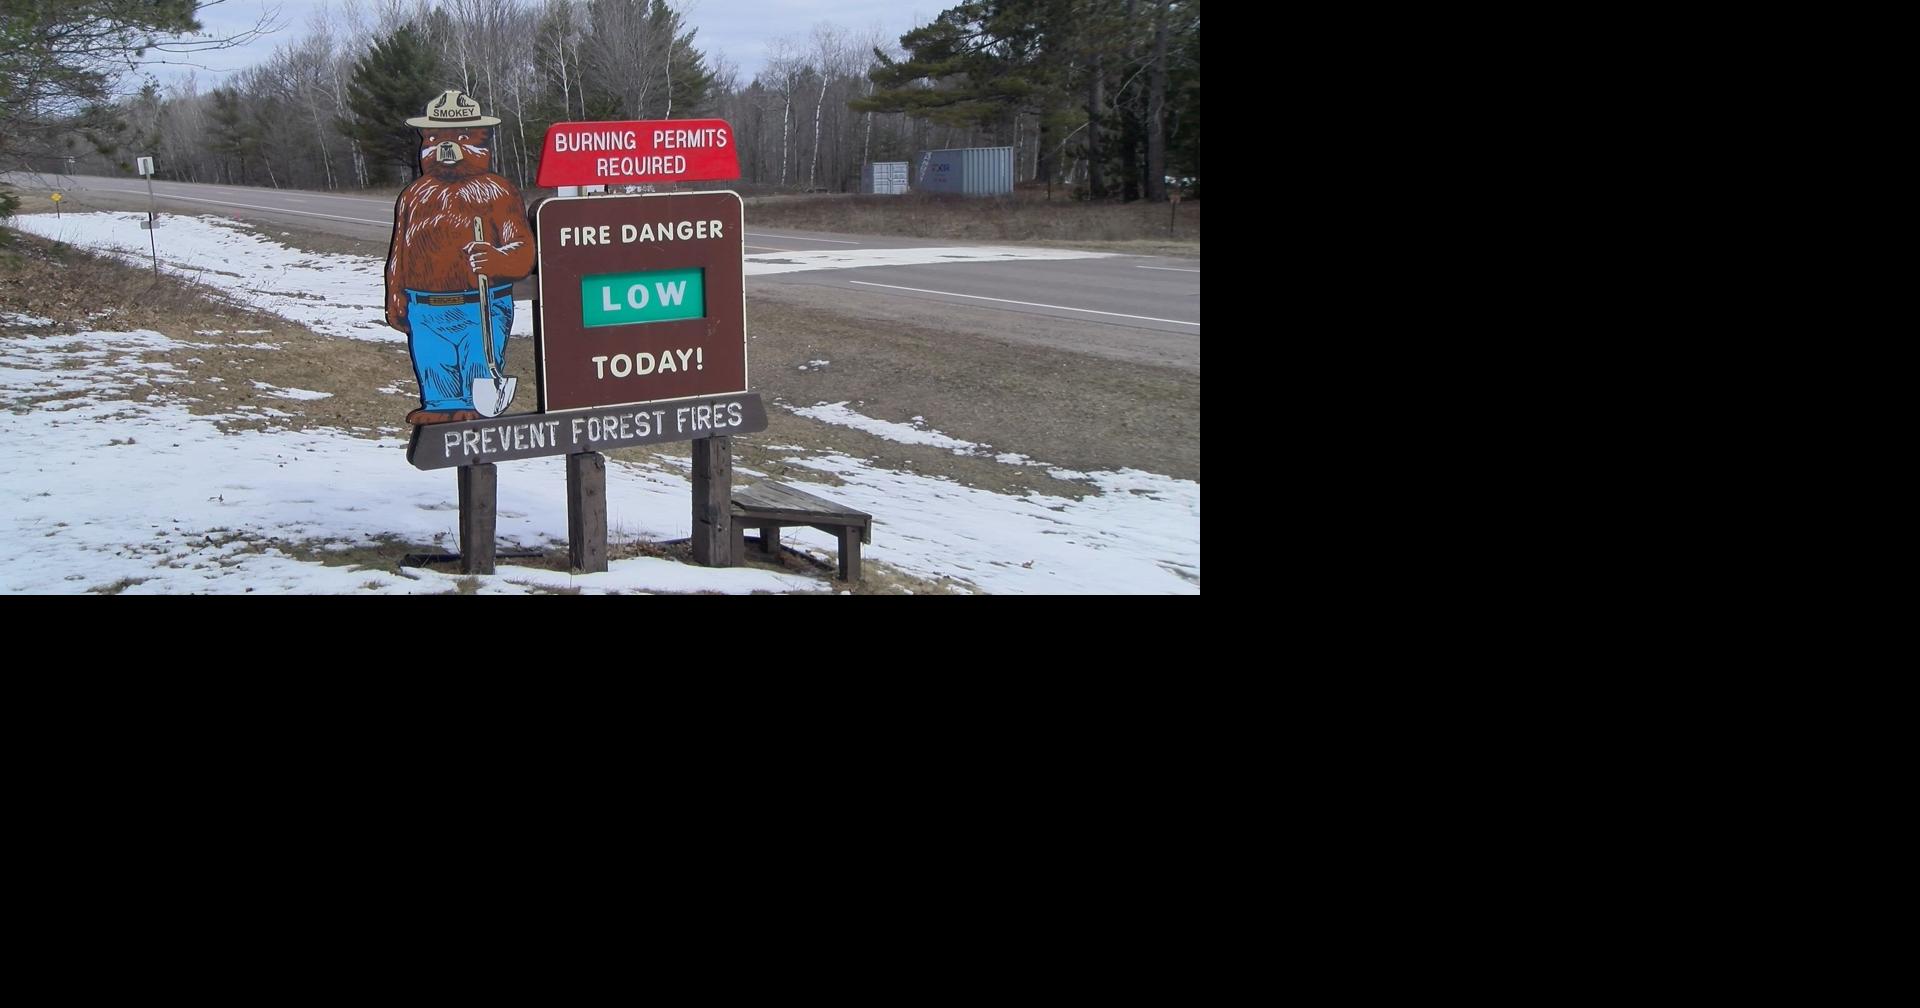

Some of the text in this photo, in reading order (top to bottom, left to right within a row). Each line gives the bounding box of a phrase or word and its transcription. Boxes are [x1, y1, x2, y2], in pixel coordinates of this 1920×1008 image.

[433, 108, 475, 118] SMOKEY
[555, 128, 728, 152] BURNING PERMITS
[597, 155, 687, 177] REQUIRED
[560, 220, 724, 247] FIRE DANGER
[602, 280, 687, 312] LOW
[592, 347, 703, 379] TODAY!
[444, 402, 744, 458] PREVENT FOREST FIRES
